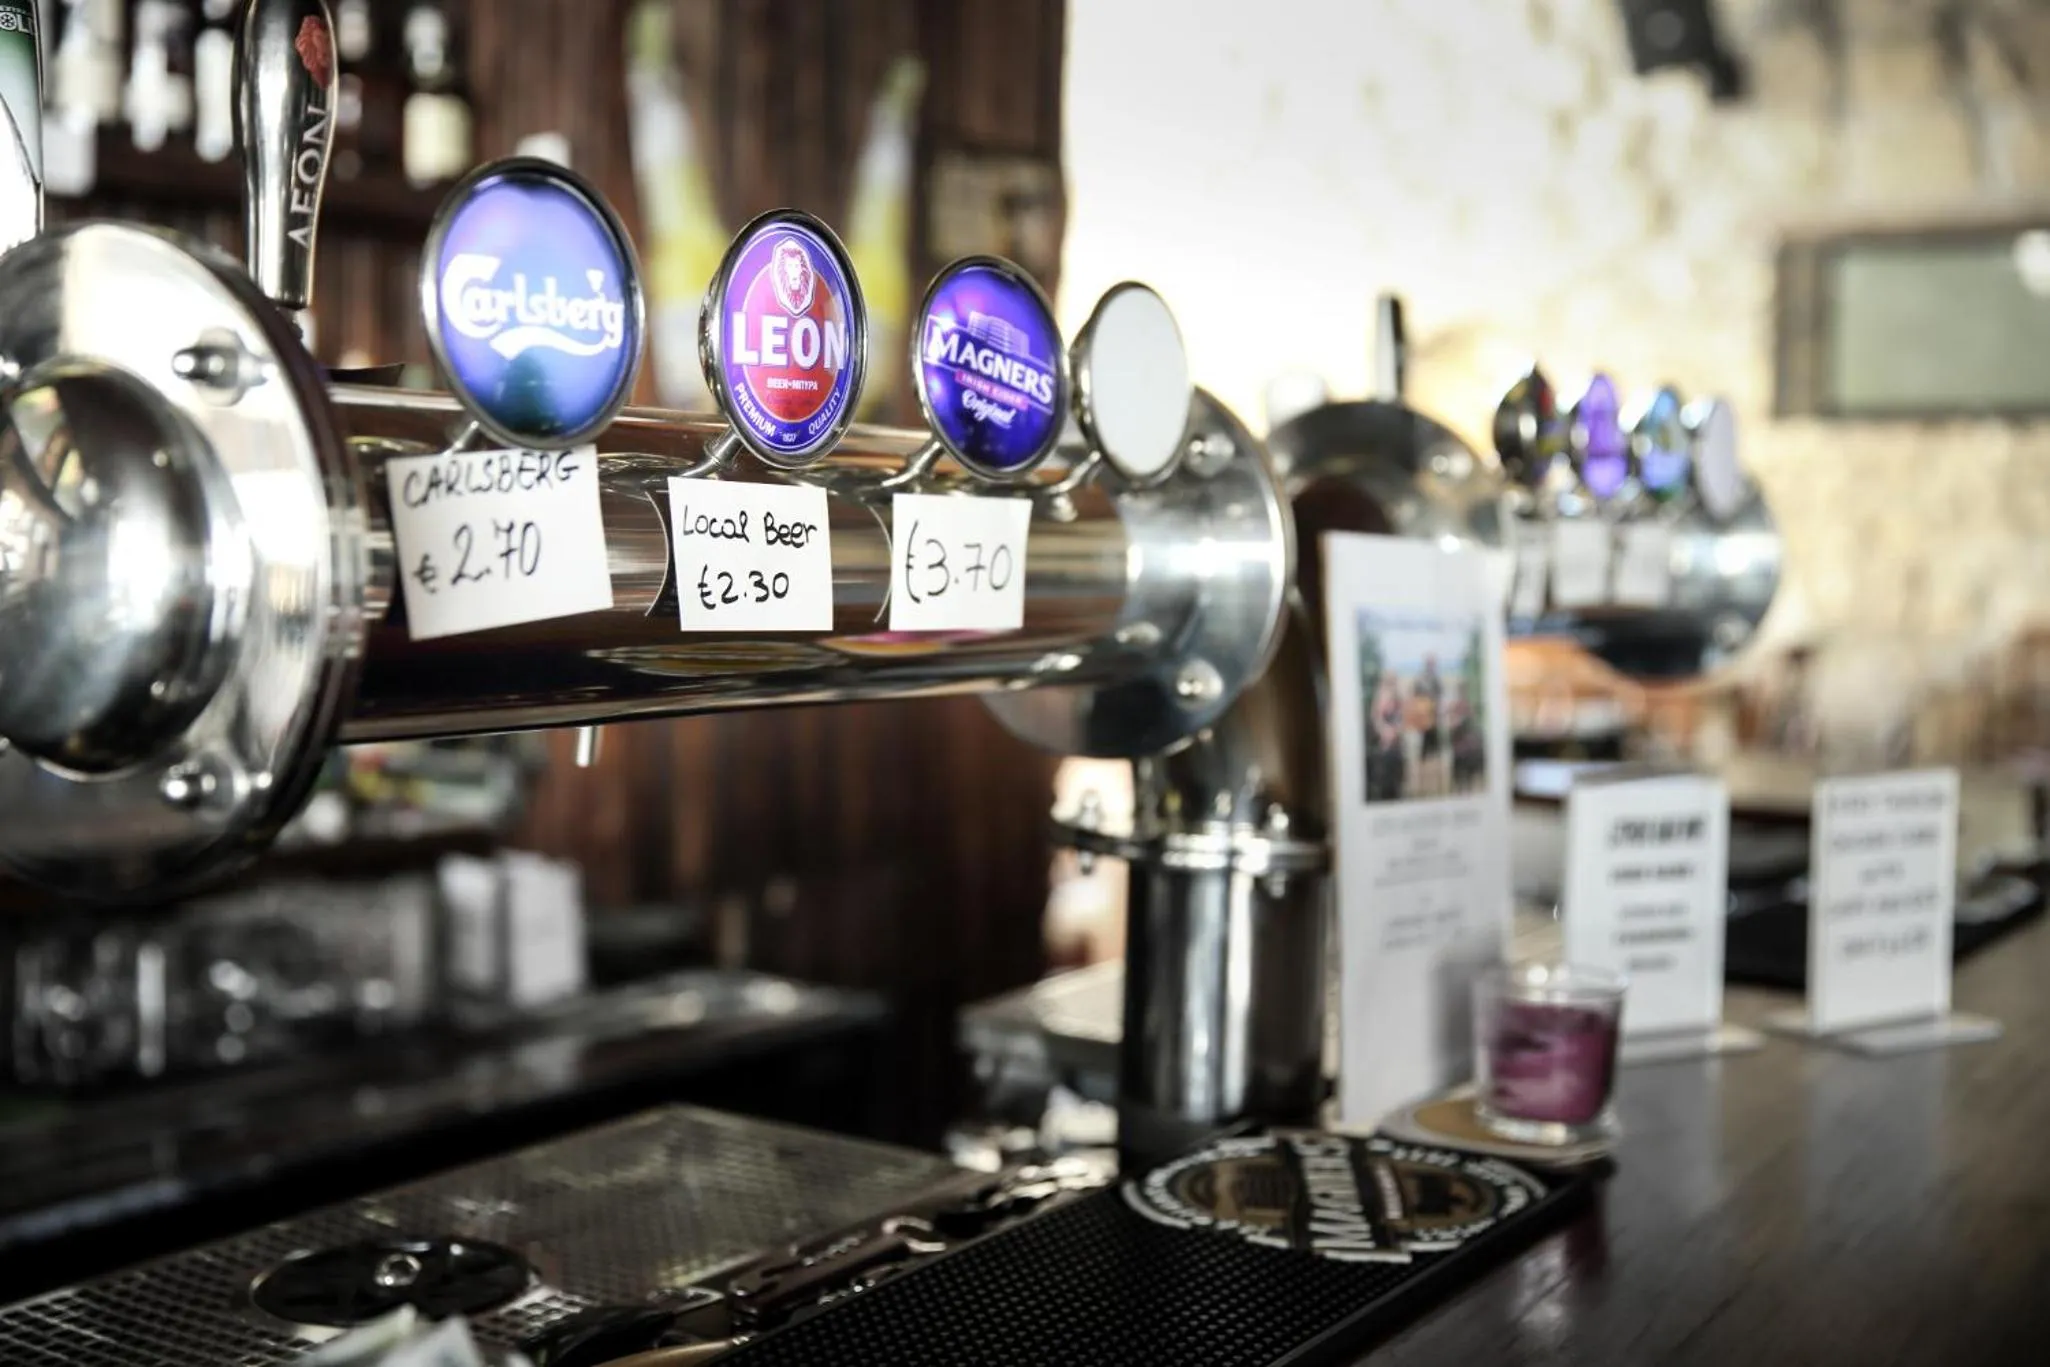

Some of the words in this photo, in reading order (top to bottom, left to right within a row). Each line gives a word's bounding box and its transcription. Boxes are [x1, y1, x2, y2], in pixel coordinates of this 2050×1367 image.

[287, 105, 329, 249] AEON
[441, 254, 625, 349] Carlsberg
[732, 311, 846, 371] LEON
[926, 322, 1055, 404] MAGNERS
[734, 382, 777, 437] PREMIUM
[808, 388, 841, 435] QUALITY
[403, 451, 580, 508] CARLSBERG
[682, 505, 750, 543] Local
[763, 511, 818, 549] Beer
[697, 564, 790, 610] €2.30
